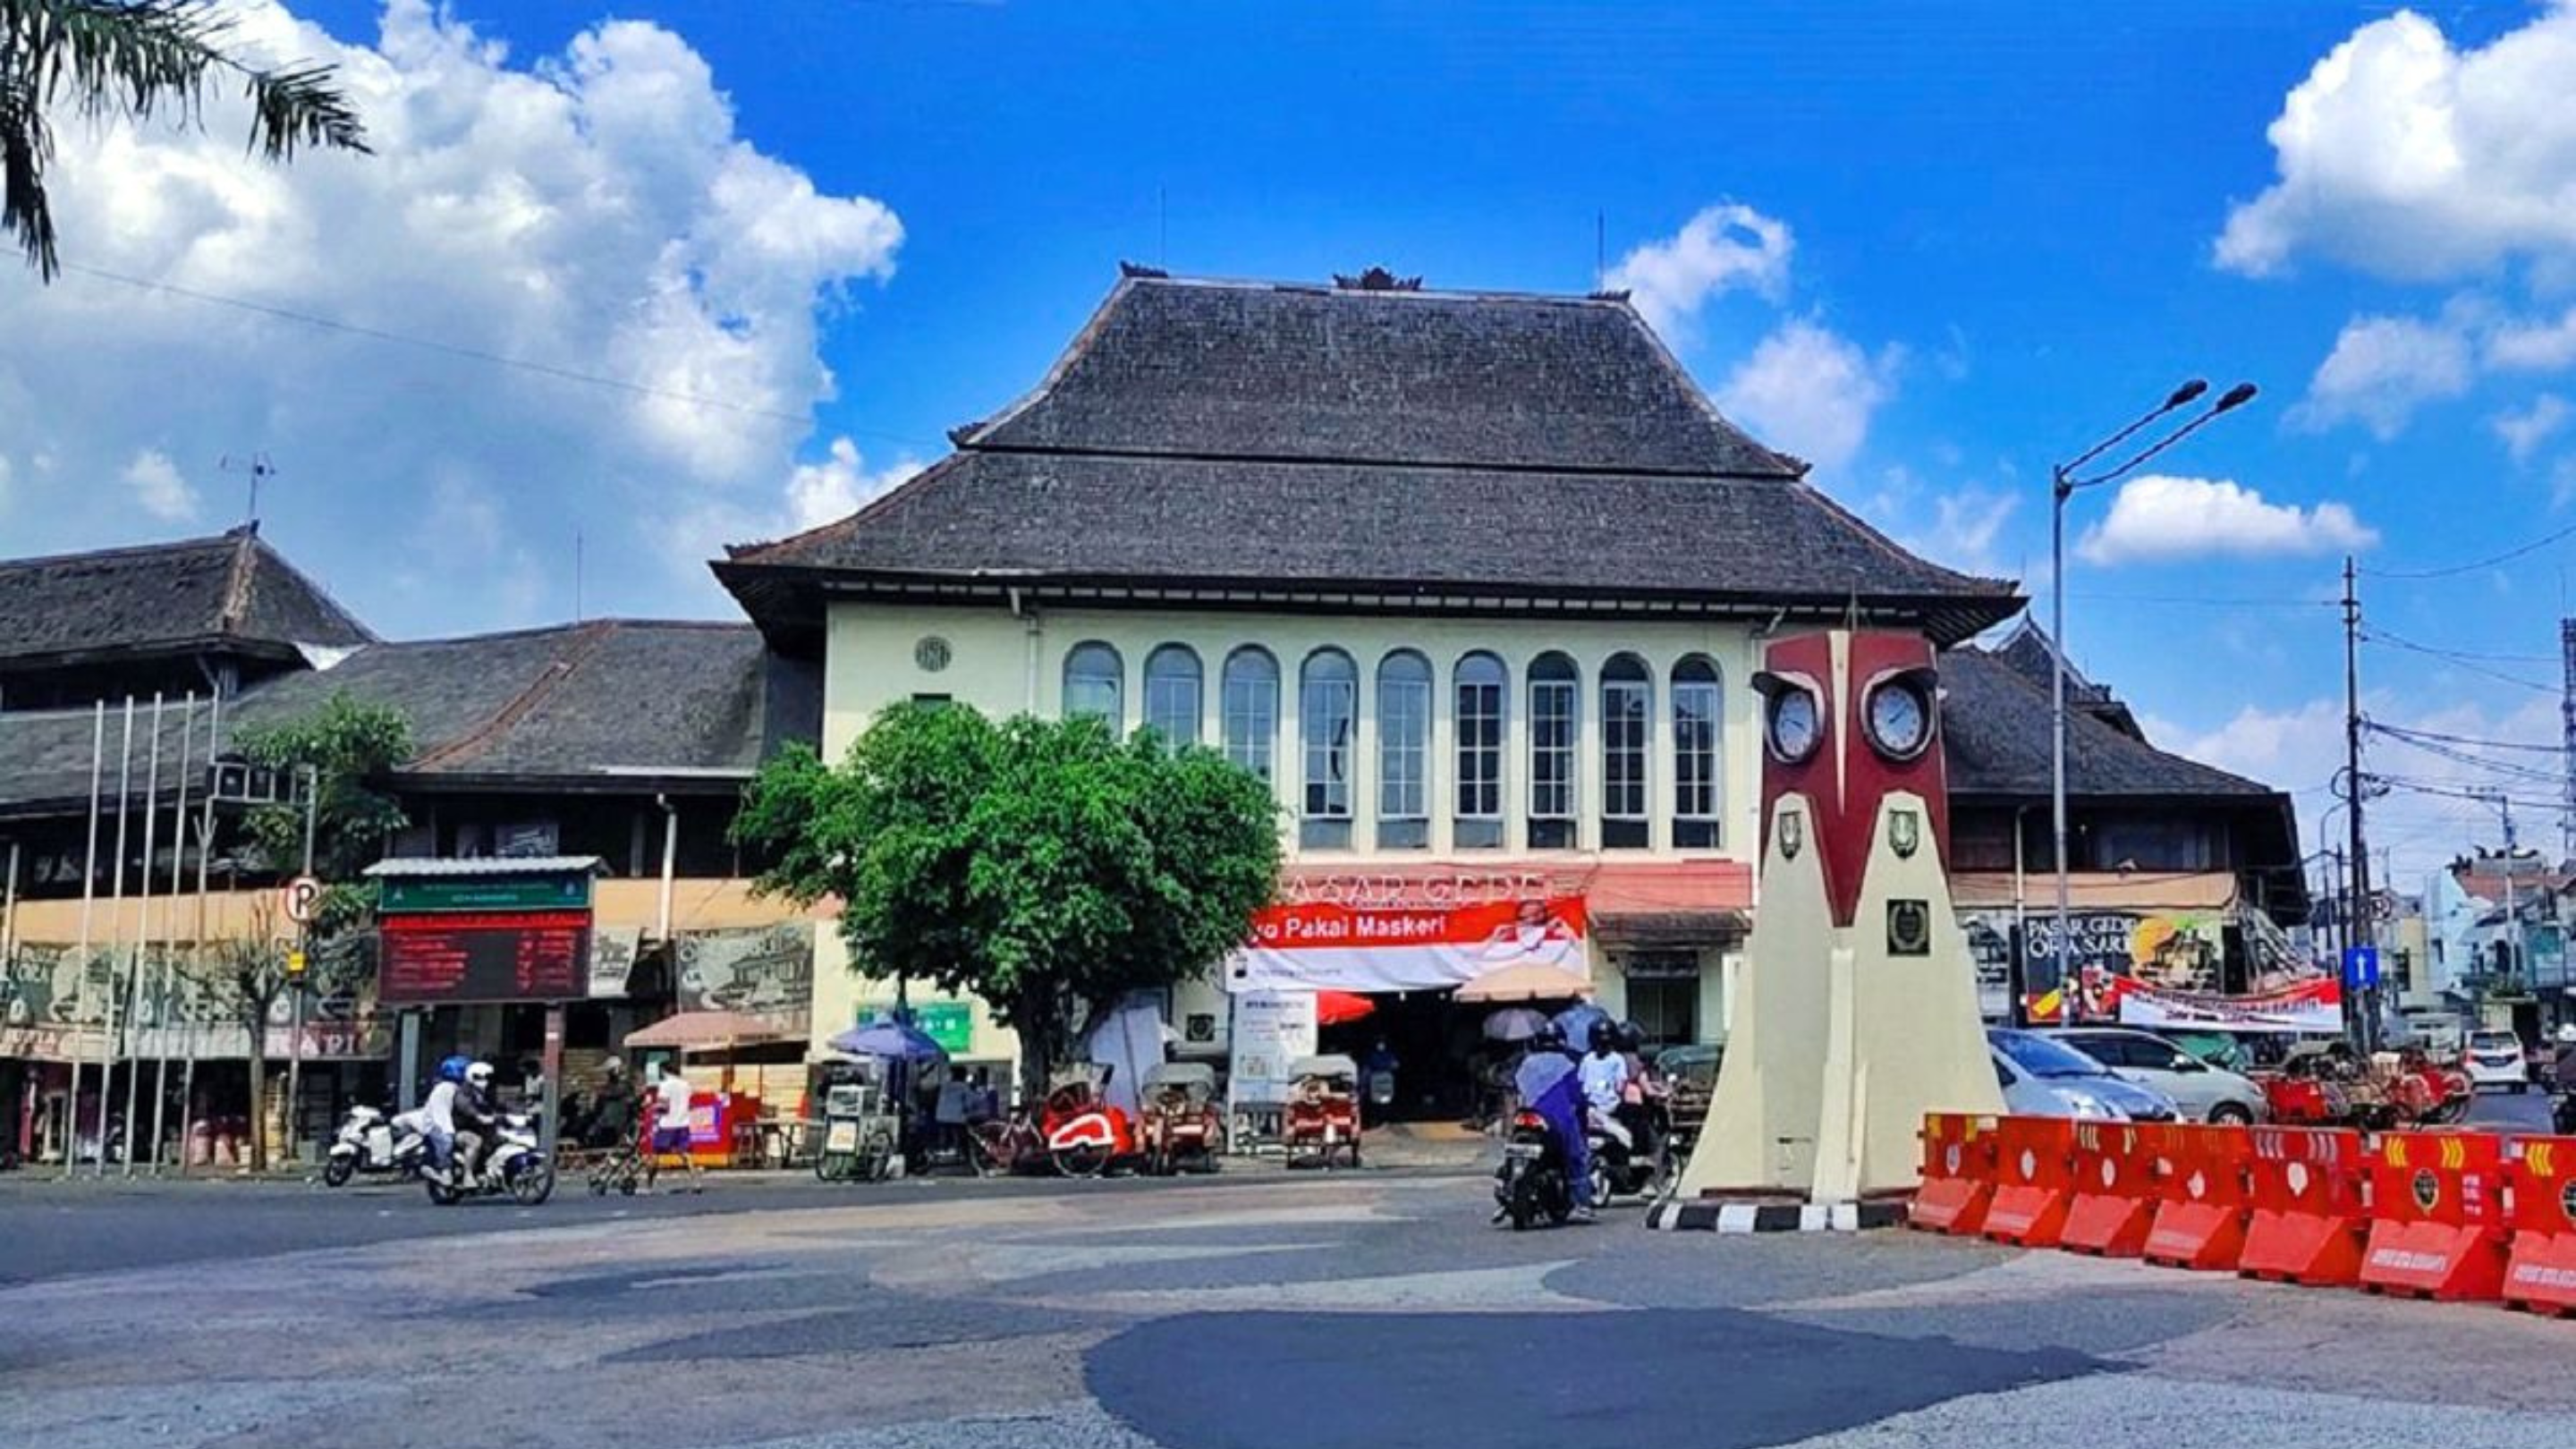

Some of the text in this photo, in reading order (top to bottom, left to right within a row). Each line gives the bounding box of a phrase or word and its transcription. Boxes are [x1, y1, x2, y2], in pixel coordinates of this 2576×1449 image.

[296, 884, 315, 915] P
[1275, 875, 1403, 902] ASAR
[1285, 916, 1349, 939] Pakai
